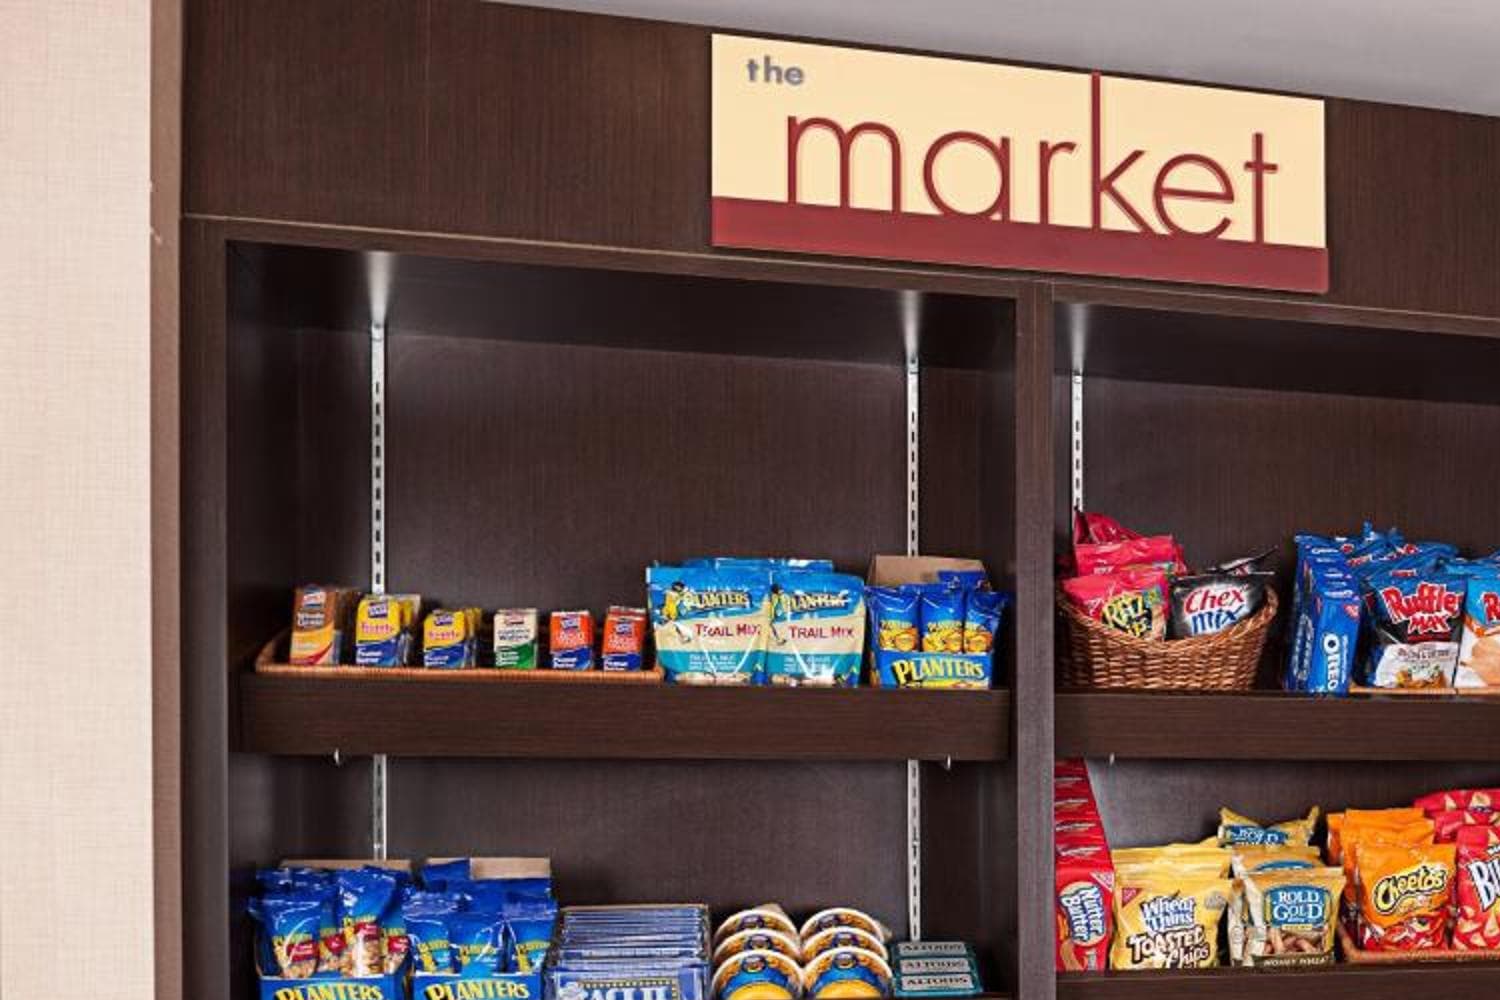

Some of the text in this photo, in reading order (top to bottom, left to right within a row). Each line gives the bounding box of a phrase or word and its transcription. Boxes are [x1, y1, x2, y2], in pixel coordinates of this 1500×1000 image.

[746, 55, 805, 86] the
[787, 70, 1279, 244] market
[1183, 584, 1246, 614] Chex
[788, 626, 828, 640] TRAIL
[891, 656, 986, 686] PLANTERS
[1140, 891, 1196, 918] Wheat
[1278, 890, 1320, 903] ROLD
[1374, 864, 1448, 916] Cheetos
[1062, 894, 1090, 942] Butter
[1078, 886, 1105, 935] Nutter
[1148, 911, 1194, 931] Thins
[1273, 903, 1323, 920] GOLD
[1127, 925, 1205, 963] TOASTED
